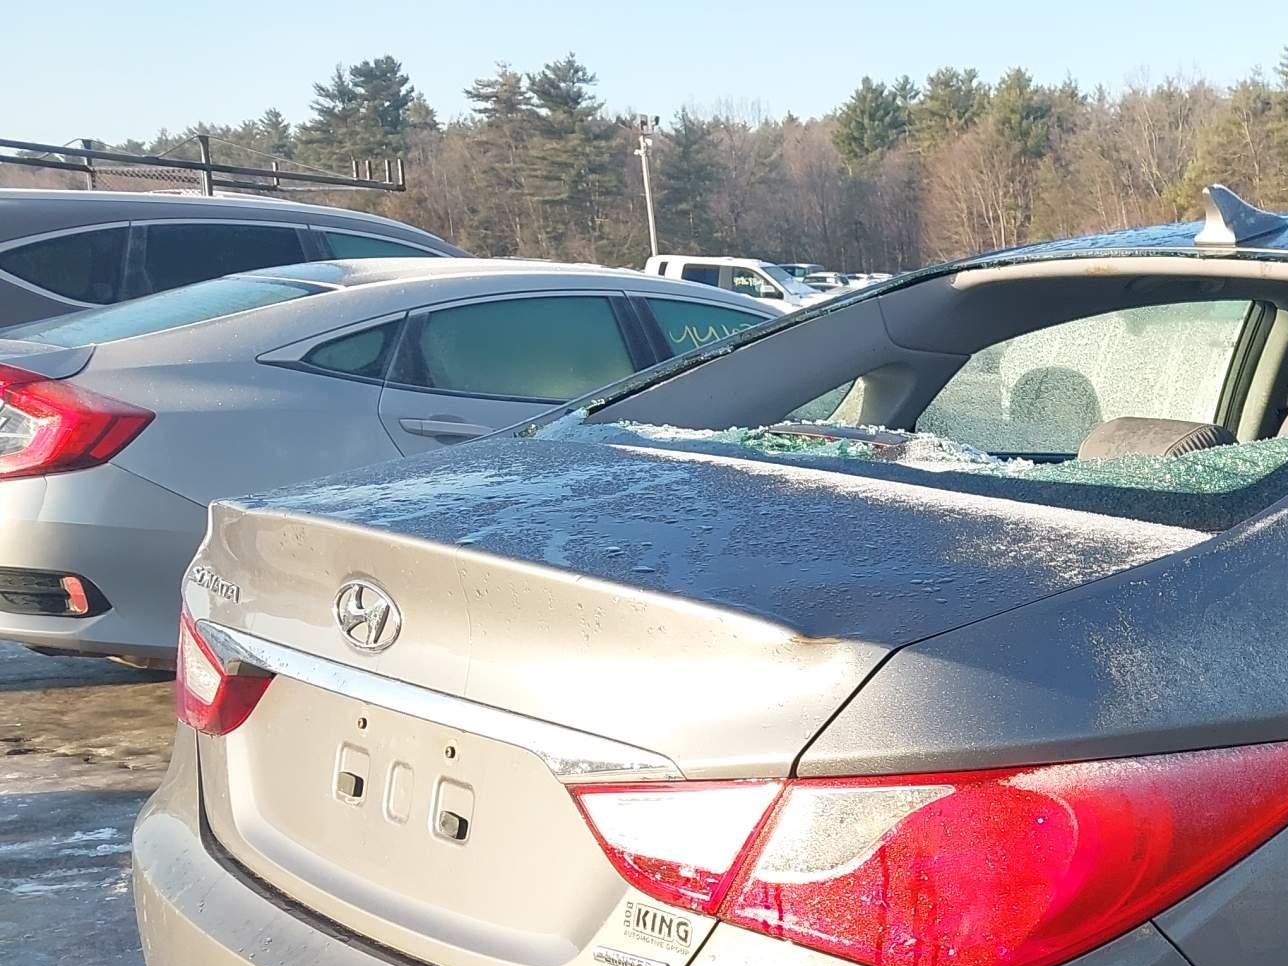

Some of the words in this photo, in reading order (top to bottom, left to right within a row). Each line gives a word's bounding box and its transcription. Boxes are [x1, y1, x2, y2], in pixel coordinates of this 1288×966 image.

[190, 565, 241, 604] SONATA
[623, 929, 665, 948] AUTOMOTIVE
[636, 908, 689, 943] KING
